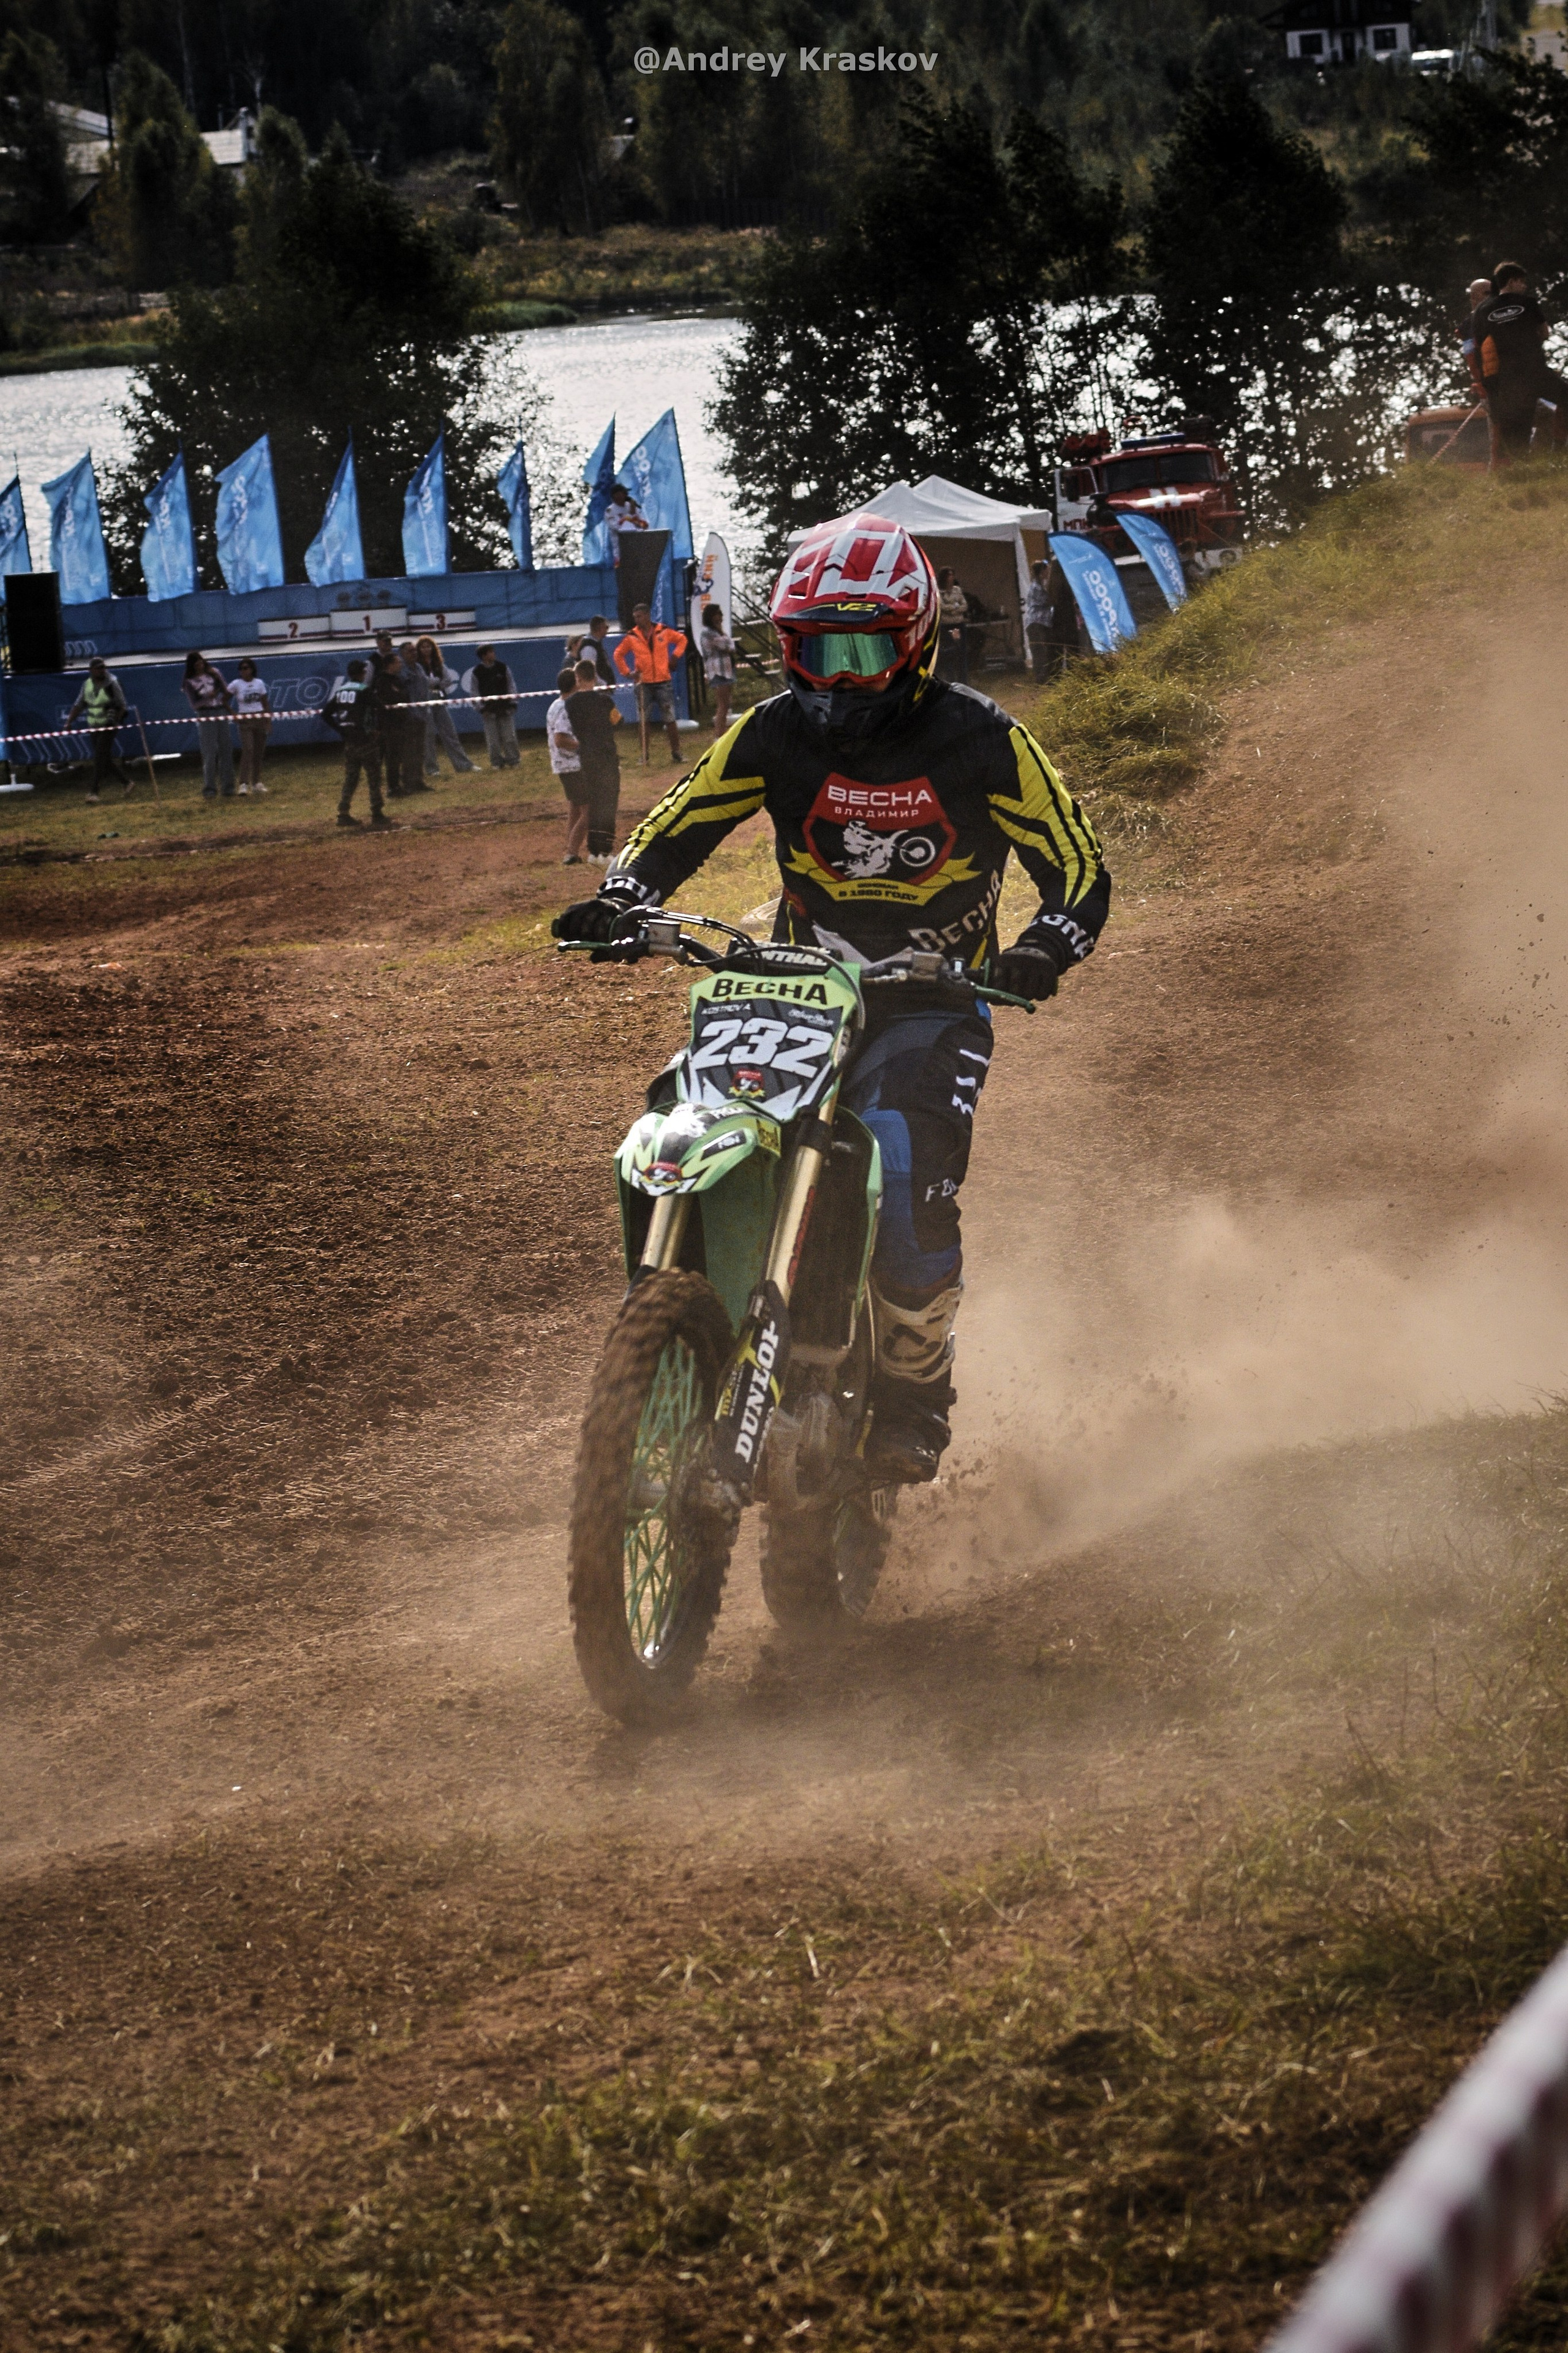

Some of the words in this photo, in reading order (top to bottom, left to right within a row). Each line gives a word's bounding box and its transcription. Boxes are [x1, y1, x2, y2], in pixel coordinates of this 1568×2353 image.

[288, 622, 299, 638] 2
[363, 615, 371, 631] 1
[436, 613, 446, 630] 3
[827, 785, 932, 806] ВЕСНА
[834, 807, 919, 818] ВЛАДИМИР
[712, 978, 829, 1005] ВЕСНА
[694, 1018, 834, 1078] 232
